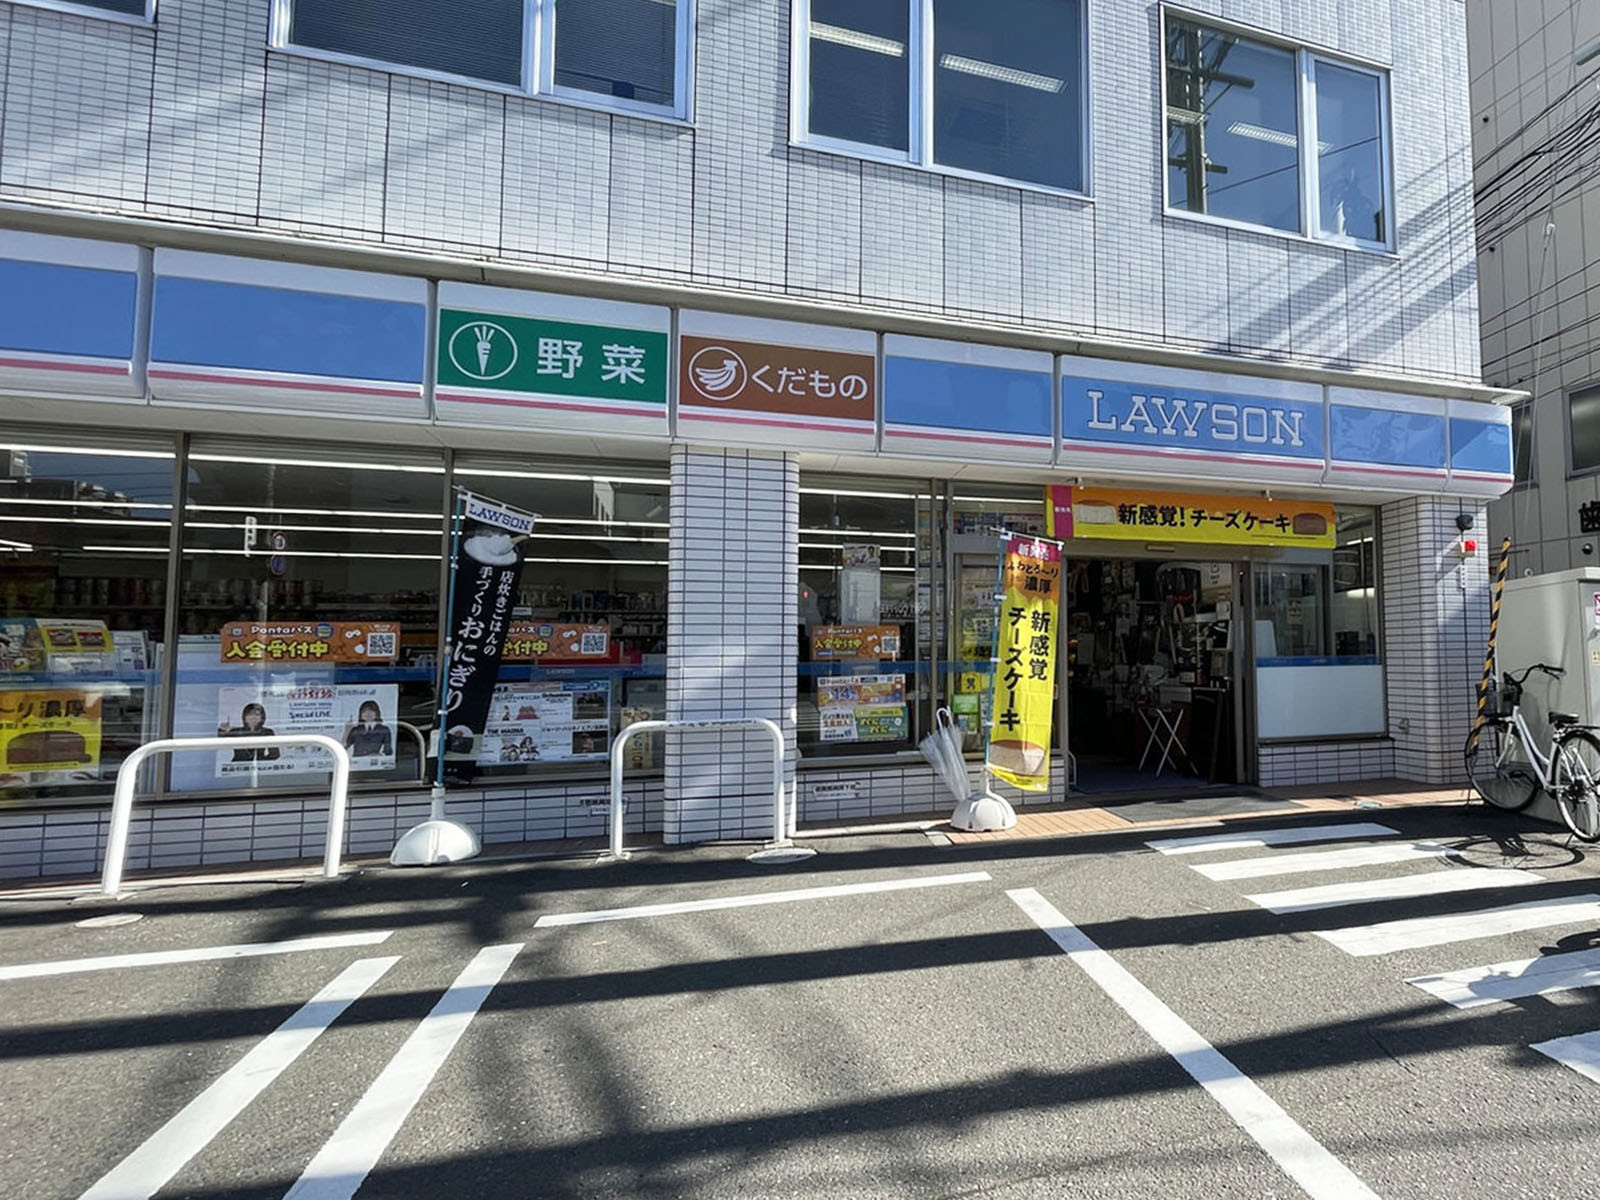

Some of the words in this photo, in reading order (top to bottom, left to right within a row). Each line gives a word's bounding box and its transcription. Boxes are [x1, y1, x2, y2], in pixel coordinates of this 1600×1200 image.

[537, 338, 647, 385] 野菜
[751, 365, 869, 401] くだもの
[1086, 389, 1305, 447] LAWSON
[468, 503, 532, 531] LAWSON
[226, 639, 329, 659] 入会受付中
[1028, 609, 1050, 681] 新感覚
[999, 607, 1027, 732] チーズケーキ
